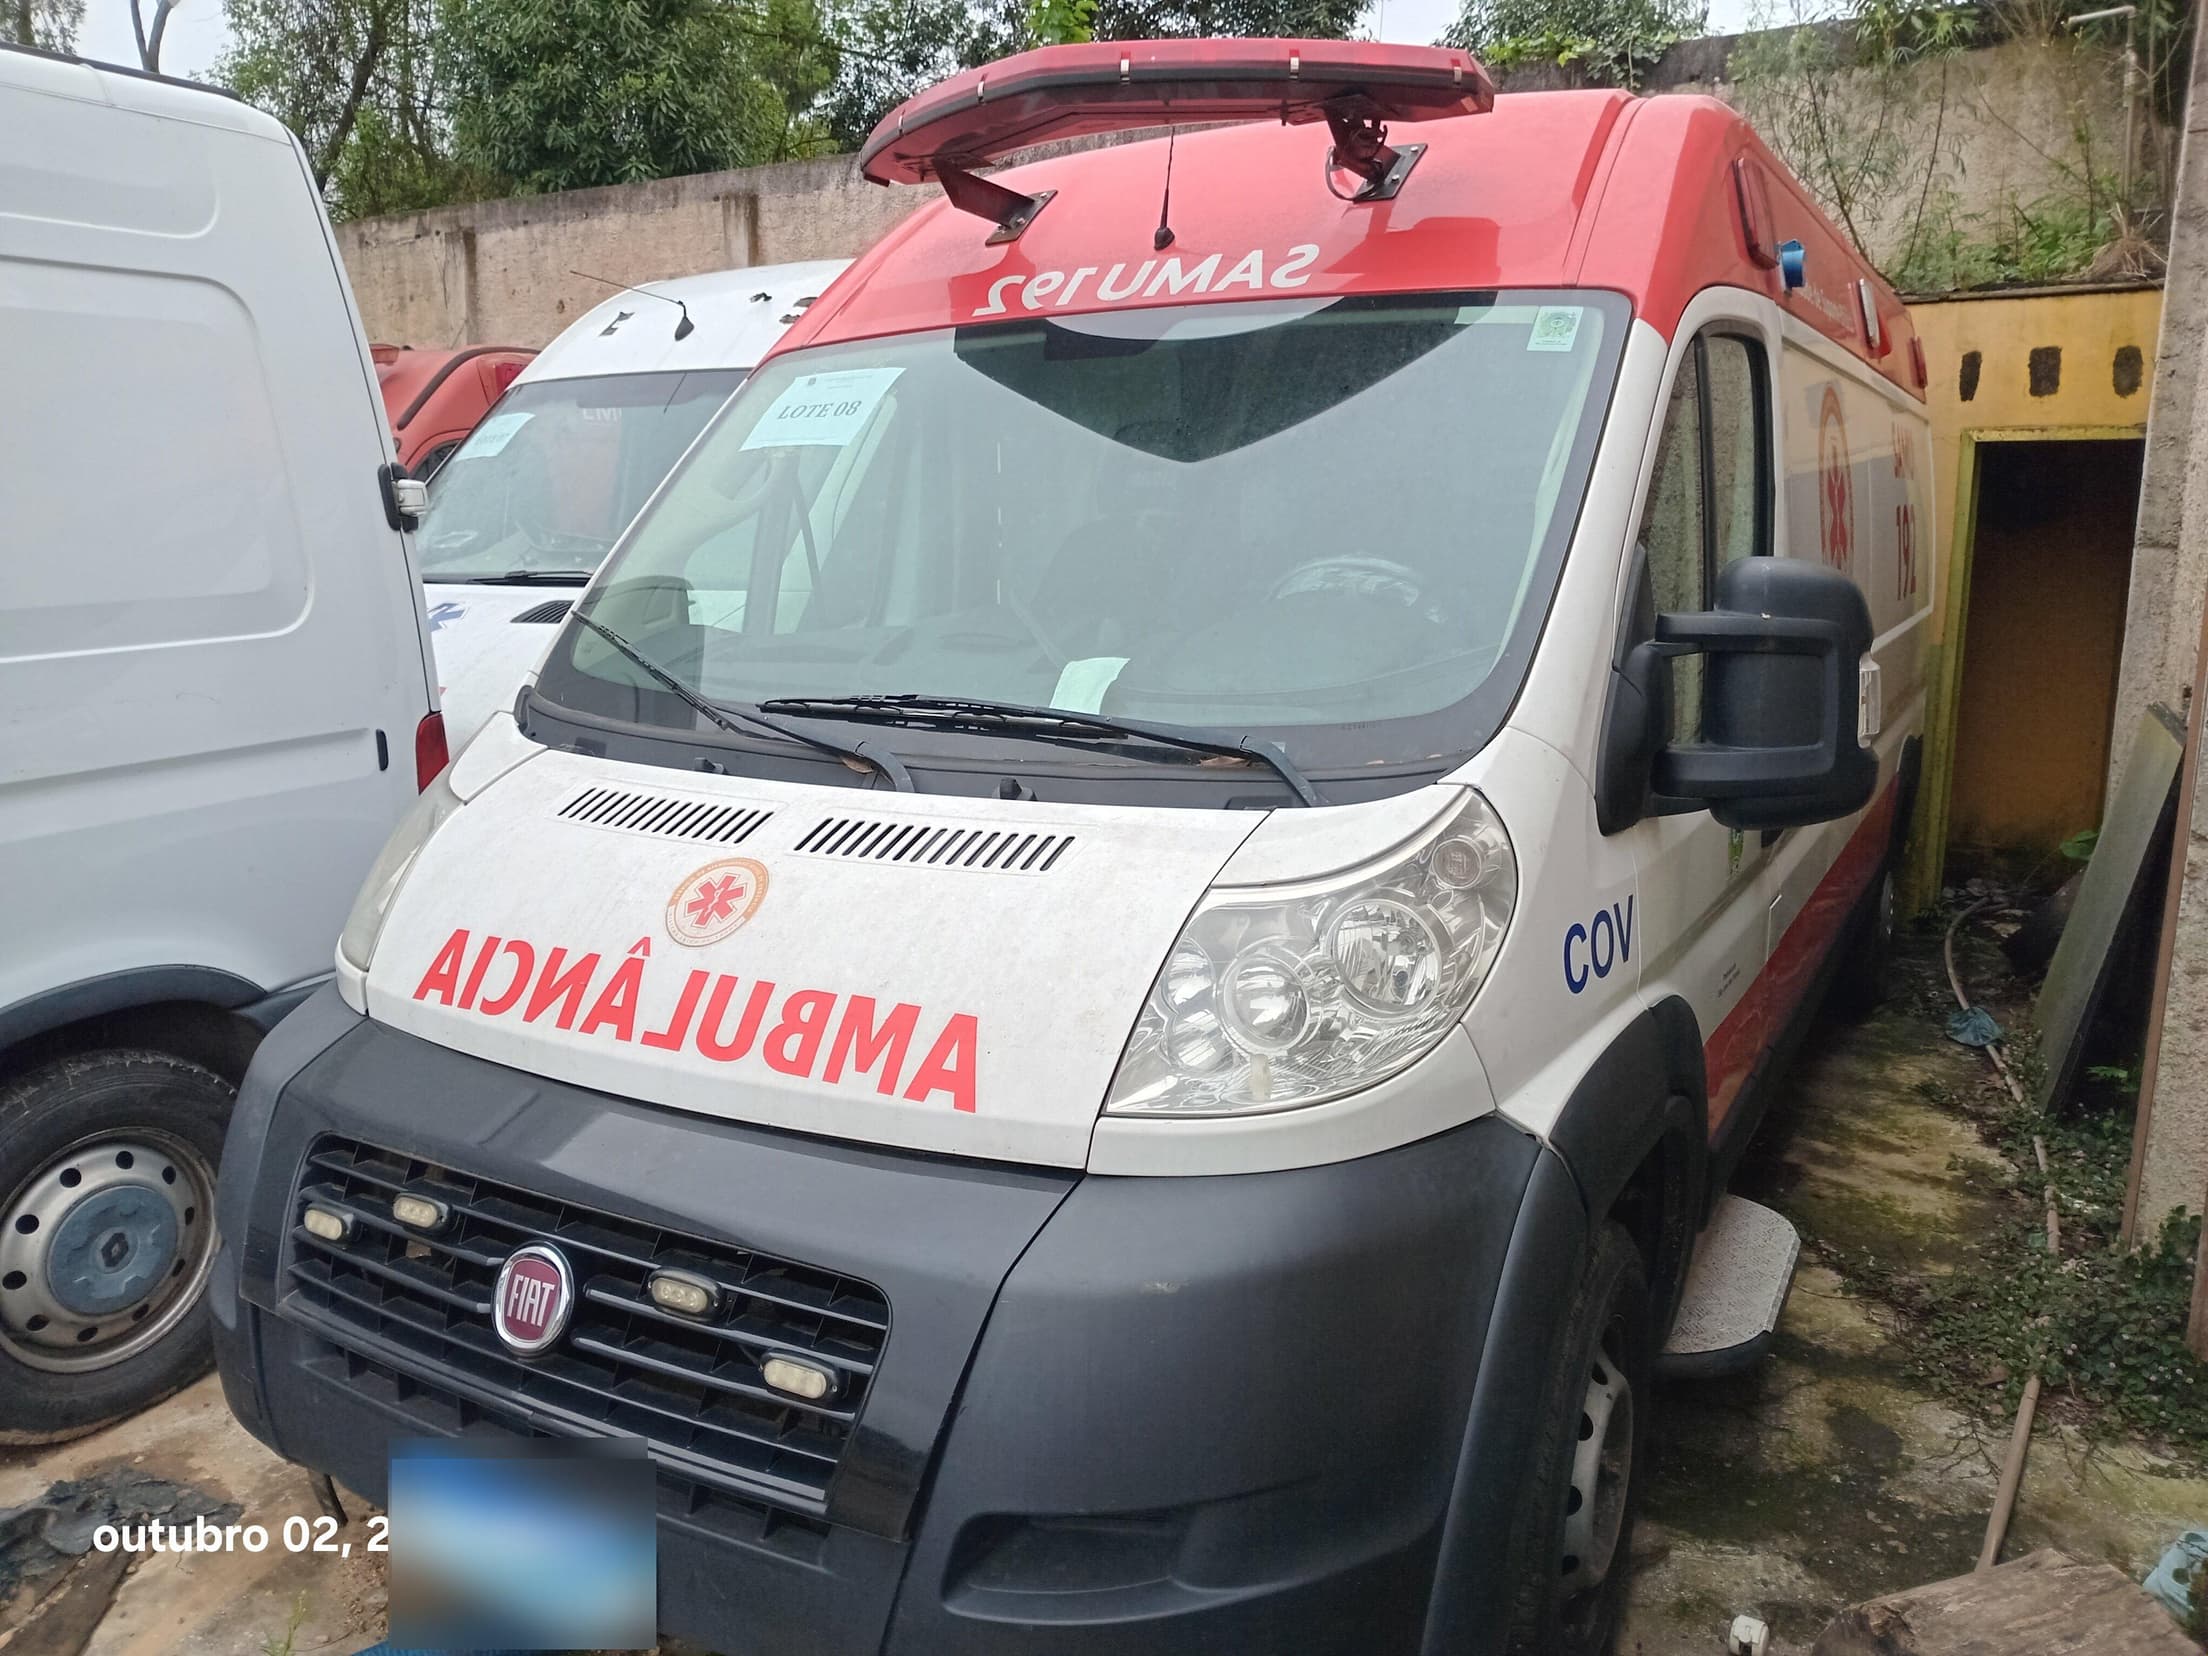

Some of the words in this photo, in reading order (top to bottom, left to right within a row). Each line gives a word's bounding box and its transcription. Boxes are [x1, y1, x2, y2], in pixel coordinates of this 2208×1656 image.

[777, 402, 834, 420] LOTE
[833, 400, 862, 417] 08
[1896, 504, 1917, 600] 192
[1563, 894, 1634, 994] COV
[506, 1273, 556, 1327] FIAT
